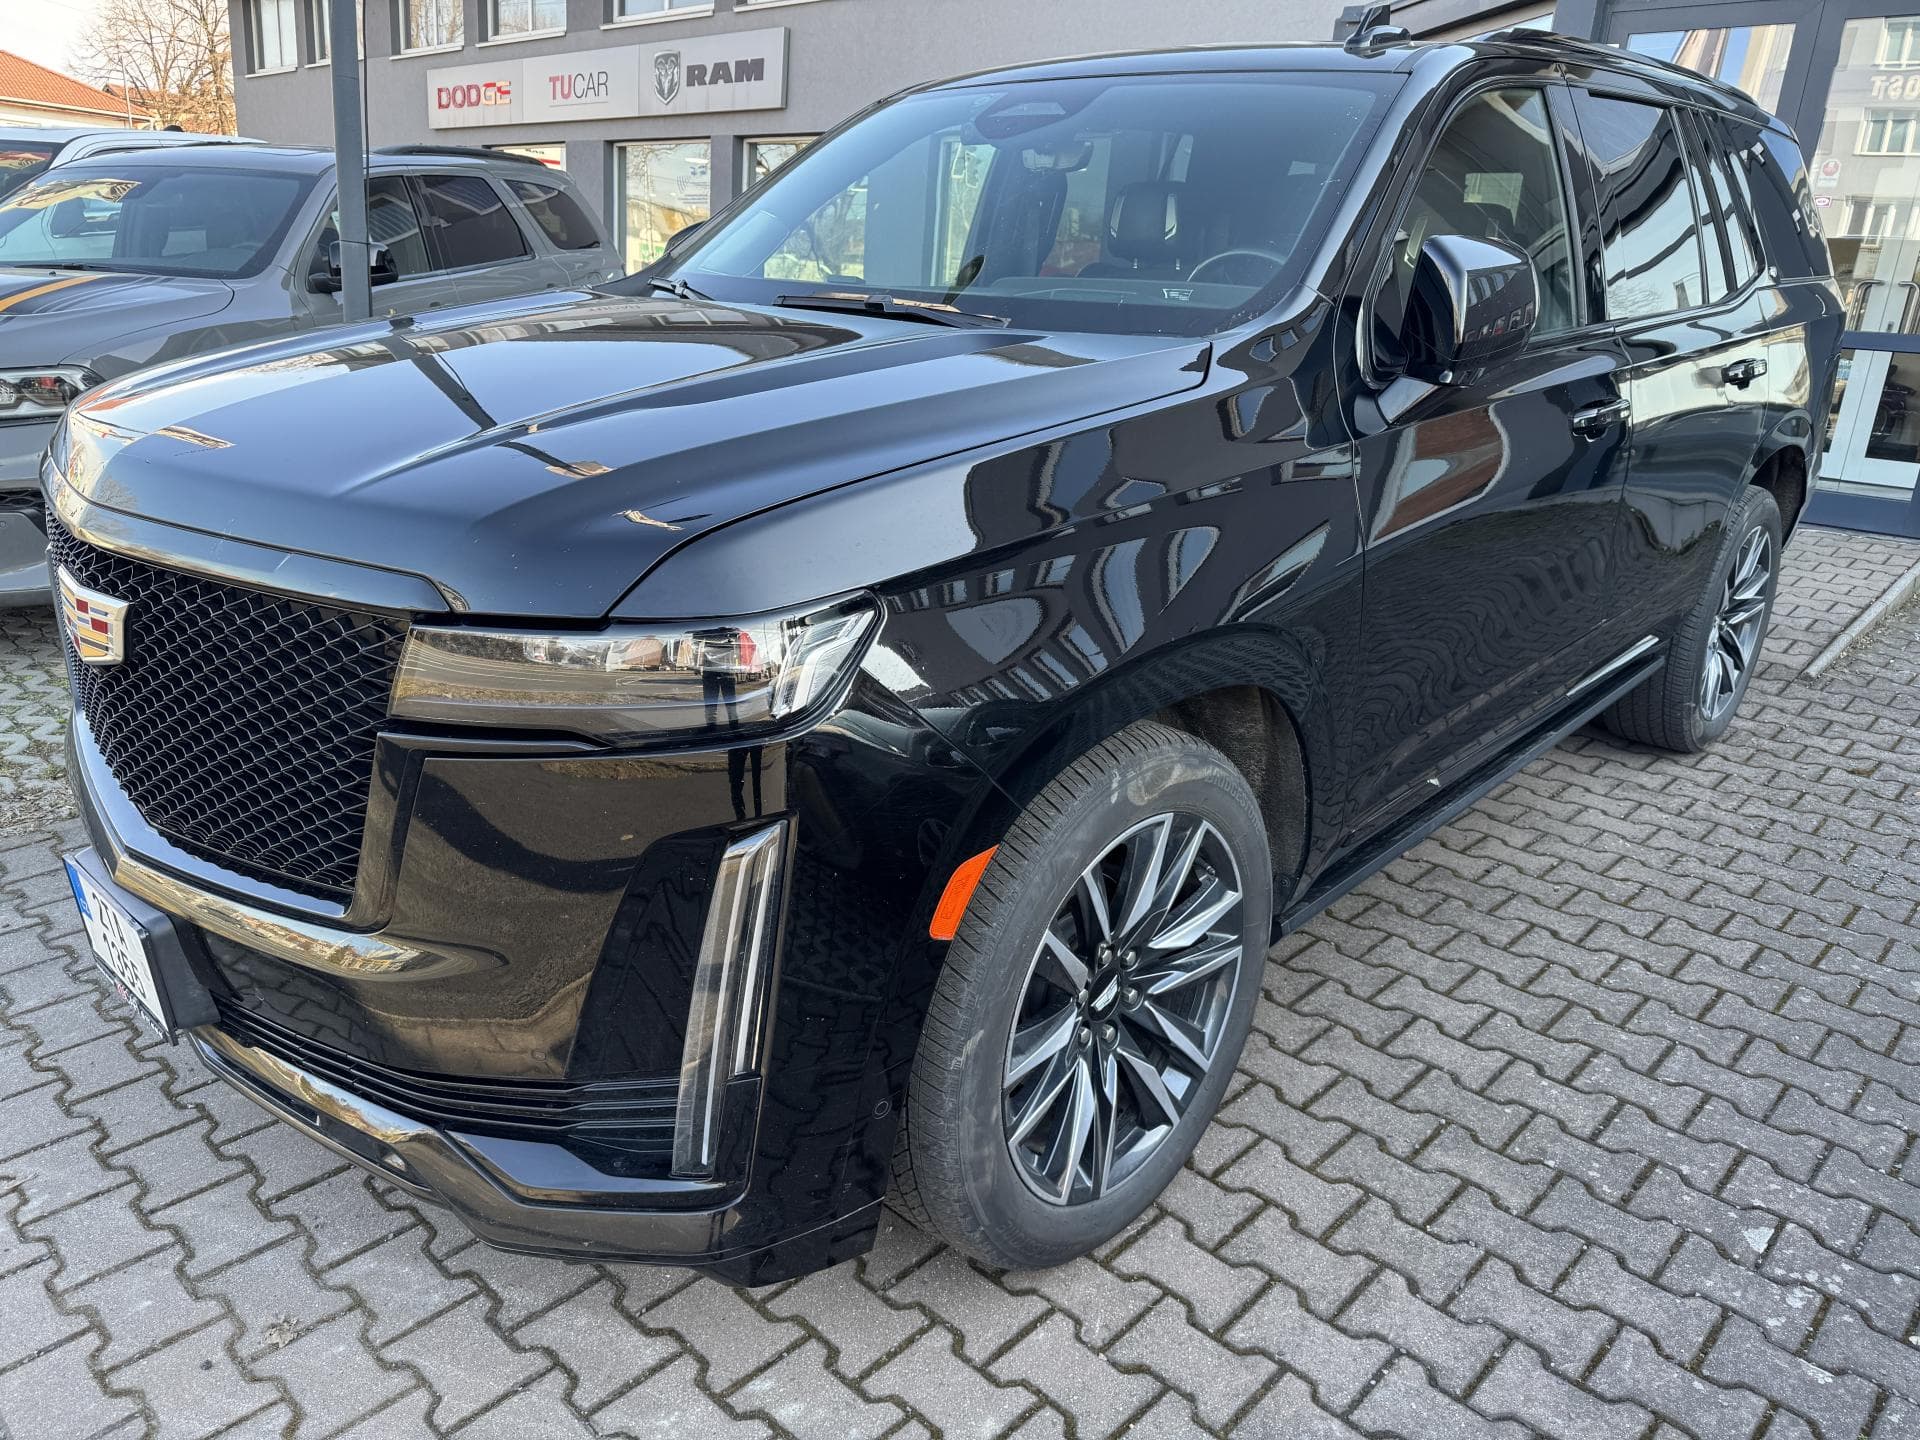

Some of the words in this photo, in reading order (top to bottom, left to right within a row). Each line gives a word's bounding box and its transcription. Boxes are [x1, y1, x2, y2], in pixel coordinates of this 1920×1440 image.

[549, 71, 608, 100] TUCAR
[686, 58, 764, 87] RAM
[437, 81, 511, 109] DODGE
[92, 892, 128, 950] 2TA
[103, 932, 146, 999] 1355
